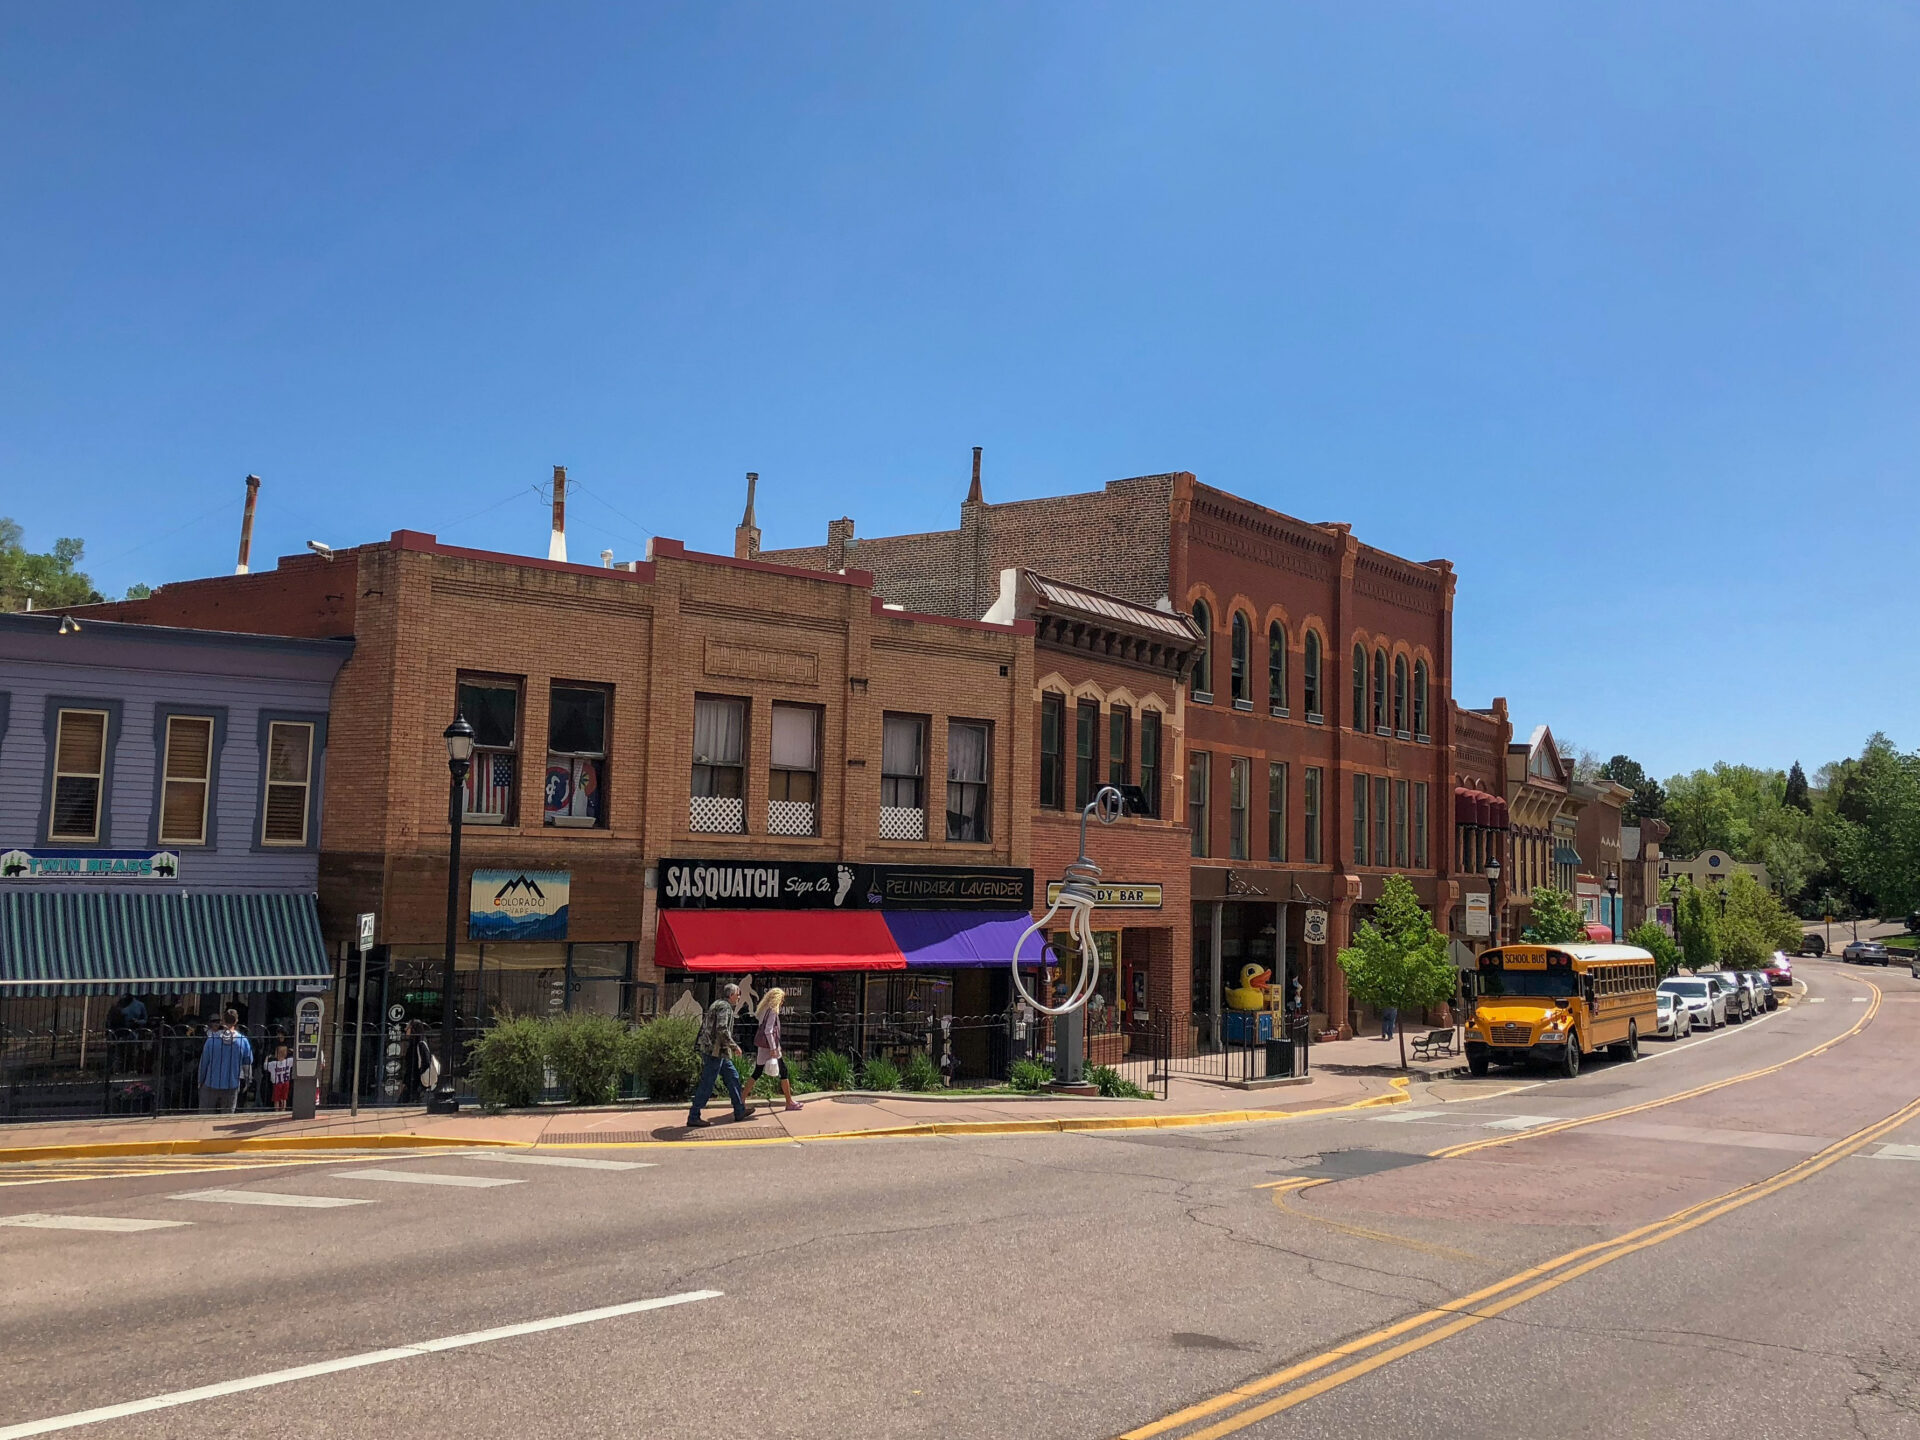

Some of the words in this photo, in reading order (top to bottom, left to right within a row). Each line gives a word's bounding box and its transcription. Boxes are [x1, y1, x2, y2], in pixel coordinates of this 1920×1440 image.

[27, 858, 80, 874] TWIN
[87, 858, 153, 875] BEARS
[666, 866, 779, 900] SASQUATCH
[784, 877, 814, 896] Sign
[816, 877, 831, 892] Co.
[886, 879, 955, 894] PELINDABA
[960, 882, 1024, 896] LAVENDER
[494, 897, 546, 907] COLORADO
[1119, 890, 1144, 900] BAR
[1504, 953, 1530, 964] SCHOOL
[1531, 953, 1545, 964] BUS
